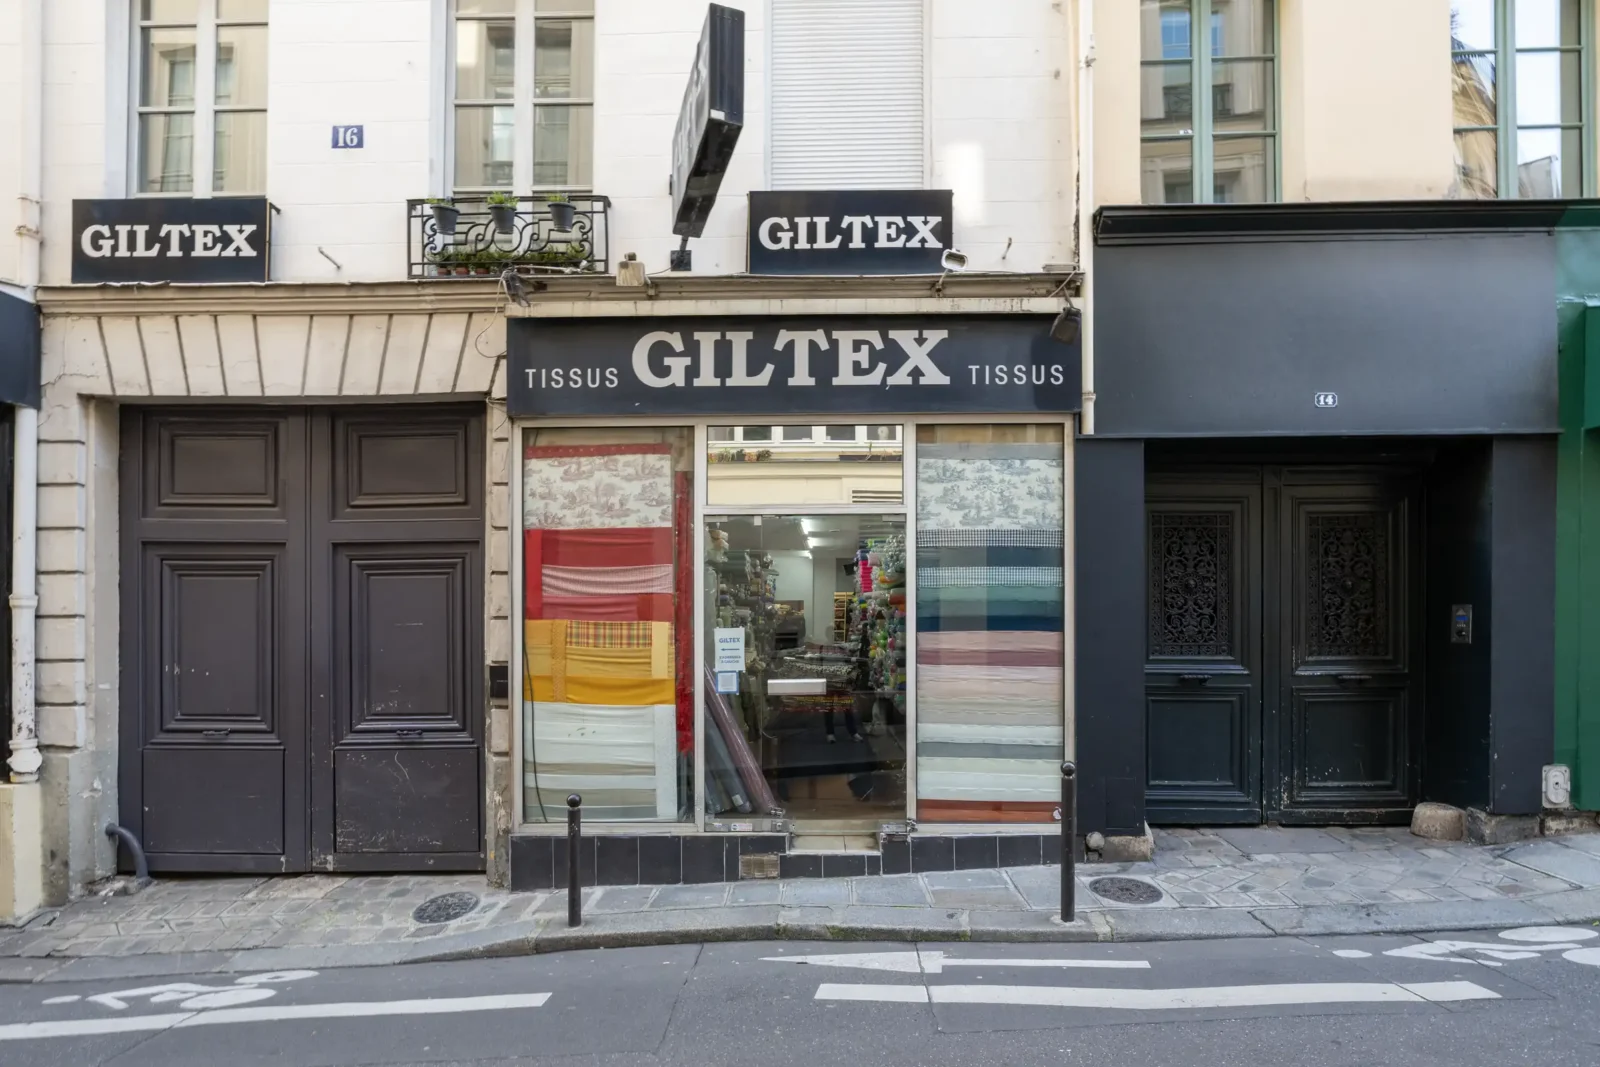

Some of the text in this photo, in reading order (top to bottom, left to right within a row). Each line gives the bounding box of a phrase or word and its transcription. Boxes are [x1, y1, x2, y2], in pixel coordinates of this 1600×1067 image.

[337, 127, 358, 147] 16
[80, 224, 258, 258] GILTEX
[759, 215, 944, 251] GILTEX
[524, 329, 1064, 389] TISSUS GILTEX TISSUS
[1318, 394, 1334, 406] 14
